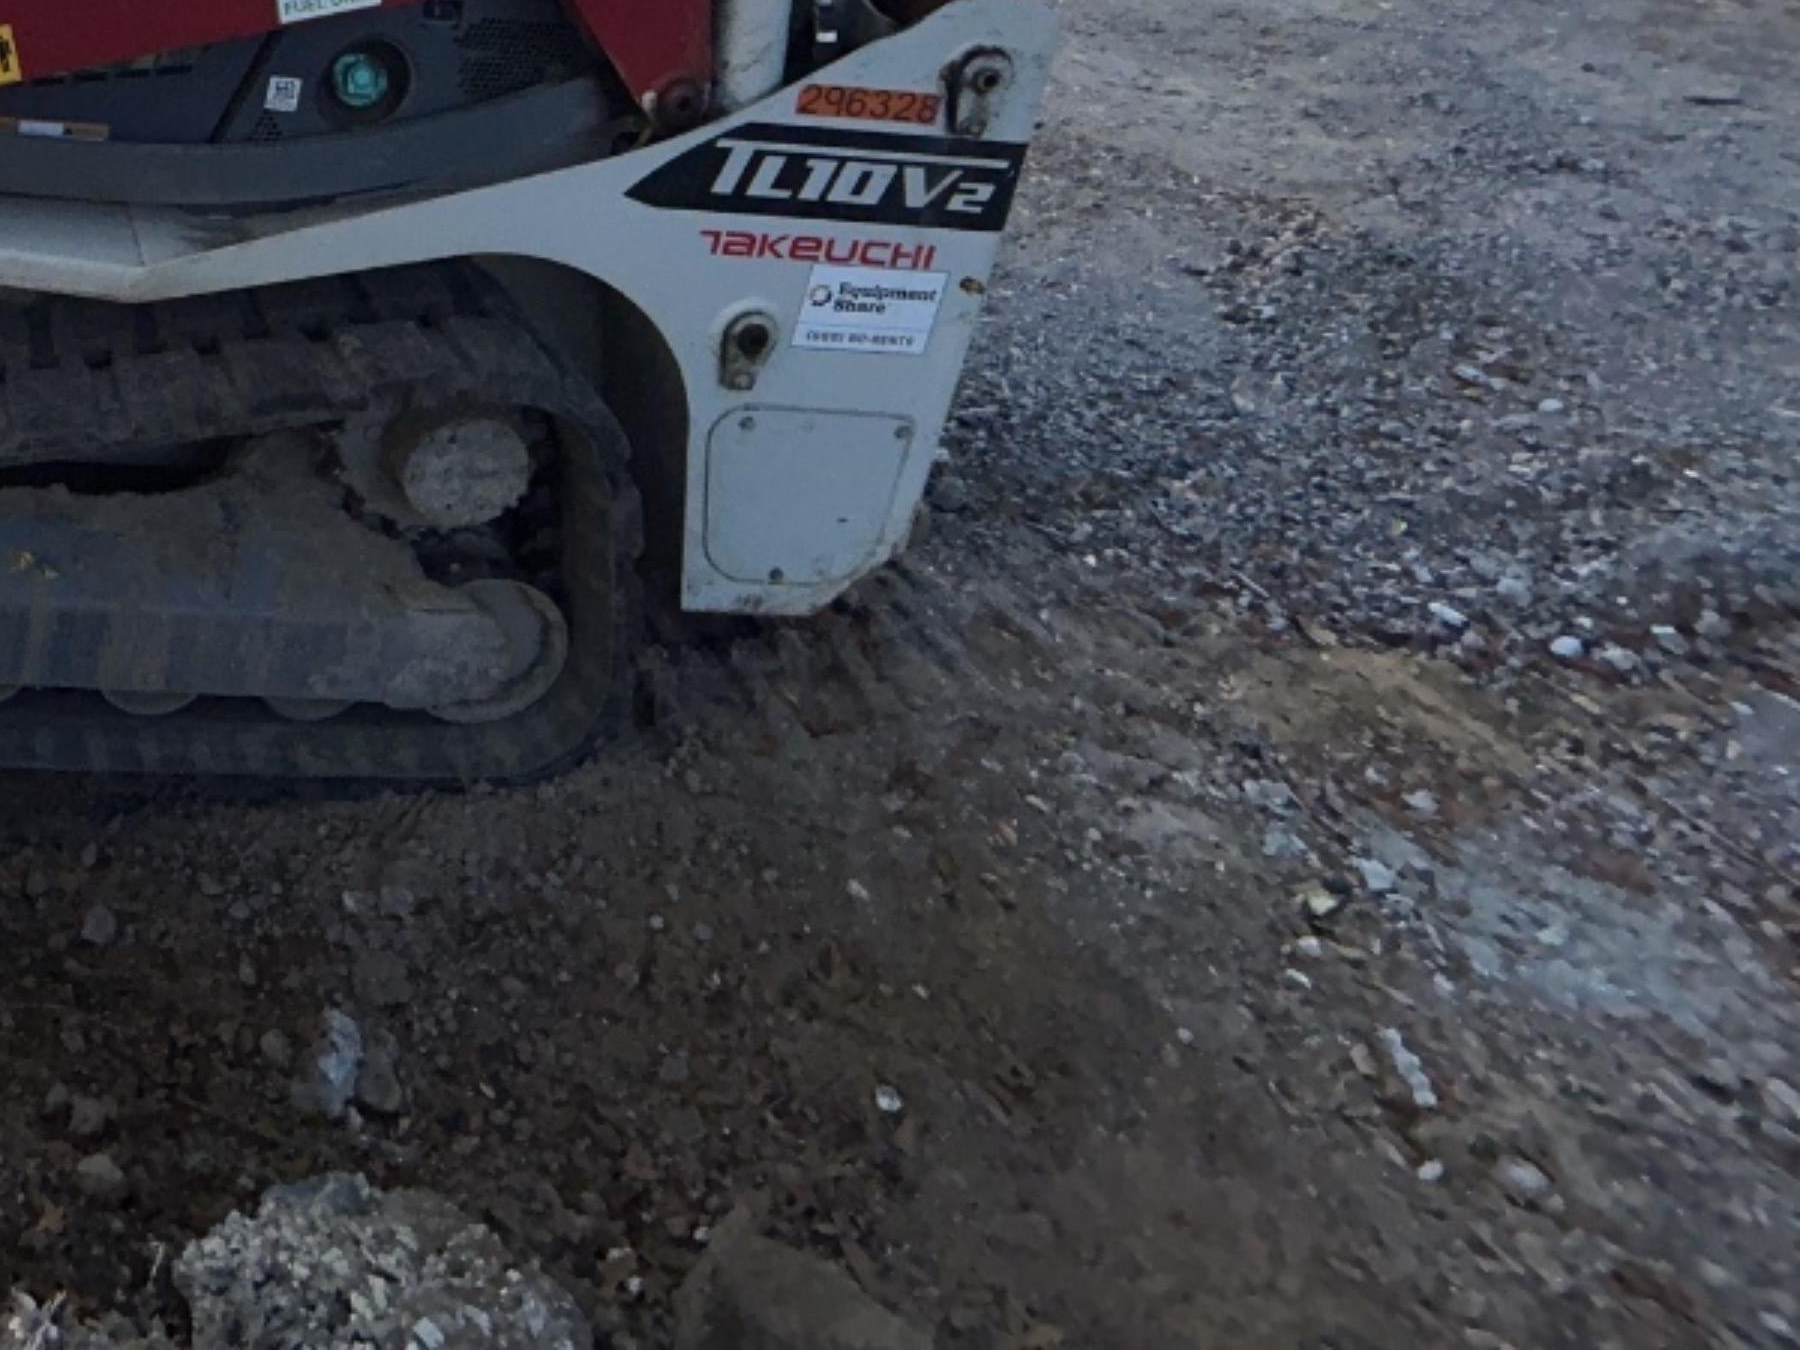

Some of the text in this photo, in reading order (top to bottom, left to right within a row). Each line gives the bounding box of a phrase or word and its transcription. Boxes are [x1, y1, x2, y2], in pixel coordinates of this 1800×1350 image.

[800, 83, 938, 123] 296328
[838, 281, 938, 301] Equipment
[833, 298, 887, 314] Share
